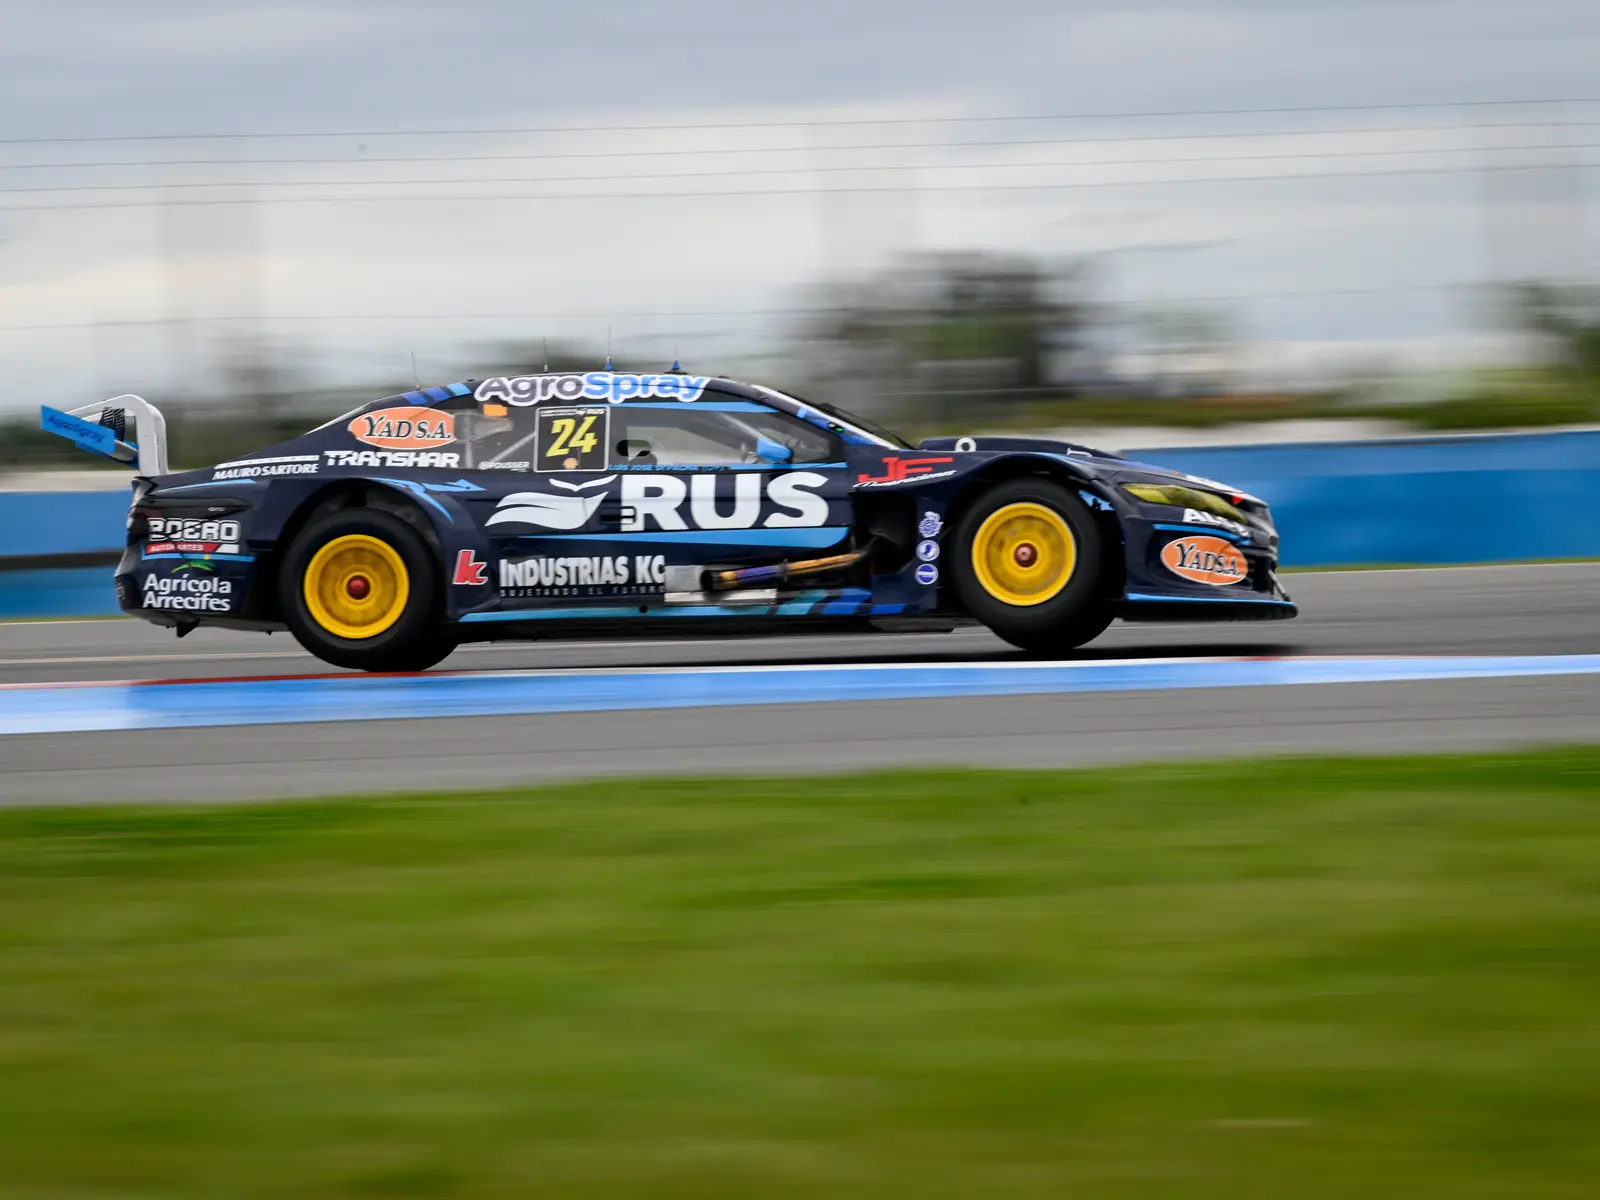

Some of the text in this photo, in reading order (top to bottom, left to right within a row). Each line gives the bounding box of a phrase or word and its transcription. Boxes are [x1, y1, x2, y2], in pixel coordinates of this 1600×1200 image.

[475, 373, 709, 405] AgroSpray
[363, 415, 452, 439] YAD S.A.
[546, 416, 598, 457] 24
[324, 450, 460, 468] TRANSHAR
[858, 457, 954, 483] JF
[212, 464, 319, 480] MAURO SARTORE
[621, 471, 830, 532] RUS
[148, 518, 241, 543] BOERO
[1173, 542, 1217, 573] YAD
[499, 554, 665, 587] INDUSTRIAS KC
[143, 573, 232, 595] Agrícola
[142, 591, 231, 612] Arrecifes
